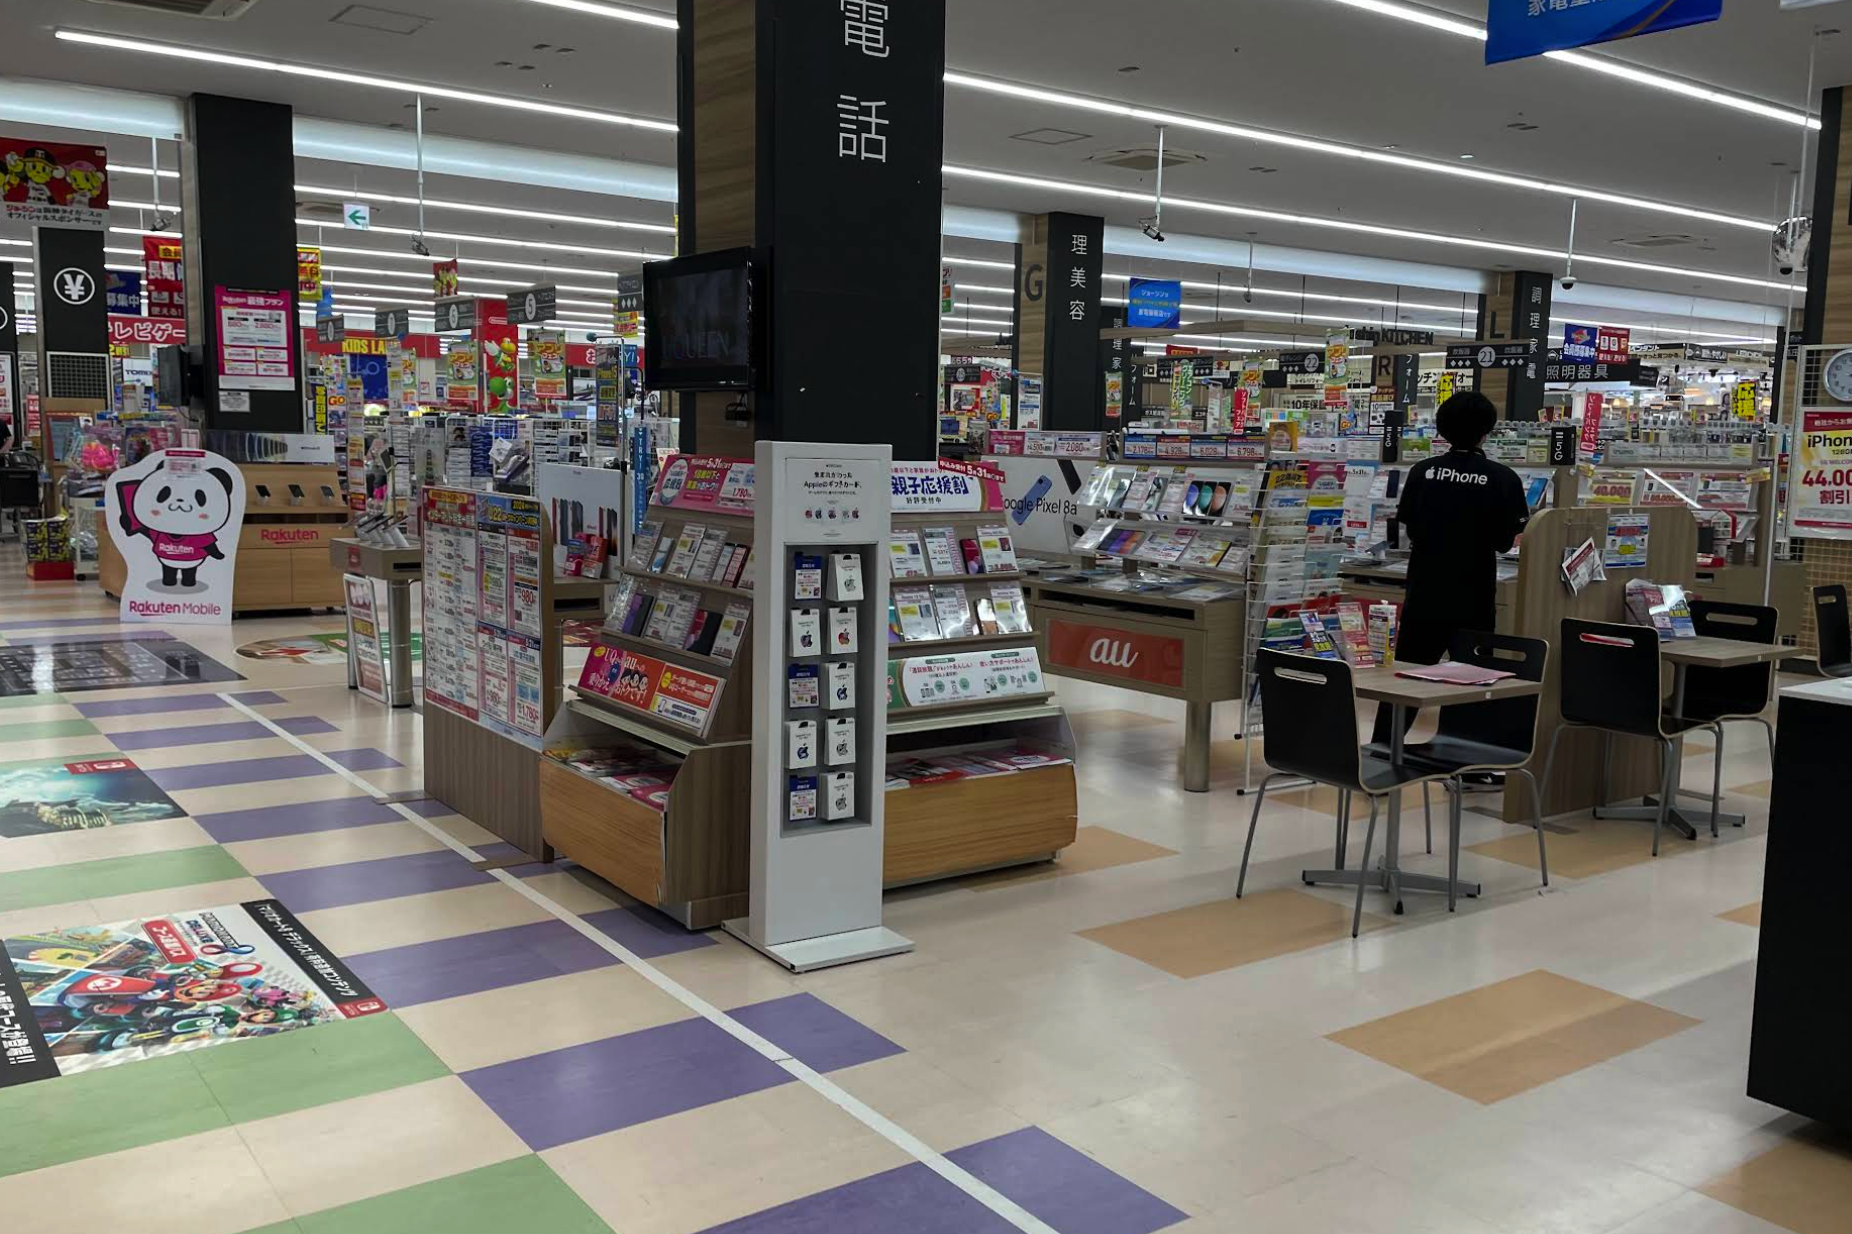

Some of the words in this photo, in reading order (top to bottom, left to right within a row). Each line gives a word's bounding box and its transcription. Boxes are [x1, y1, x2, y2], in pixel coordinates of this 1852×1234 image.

[837, 0, 890, 163] 電話
[1024, 264, 1043, 301] G
[1069, 234, 1088, 321] 理美容
[108, 322, 186, 342] レビゲー
[1489, 310, 1505, 339] L
[342, 338, 368, 354] KIDS
[371, 340, 387, 354] LA
[1305, 354, 1319, 368] 22
[1379, 355, 1392, 376] R
[1129, 353, 1138, 406] フォーム
[1546, 364, 1609, 379] 照明器具
[1436, 468, 1488, 485] iPhone
[1003, 499, 1033, 515] oogle
[1035, 499, 1061, 515] Pixel
[1063, 500, 1078, 516] 8a
[261, 528, 319, 545] Rakuten
[158, 542, 195, 556] Rakuten
[129, 600, 181, 617] Rakuten
[182, 602, 221, 616] Mobile
[1090, 637, 1139, 669] au
